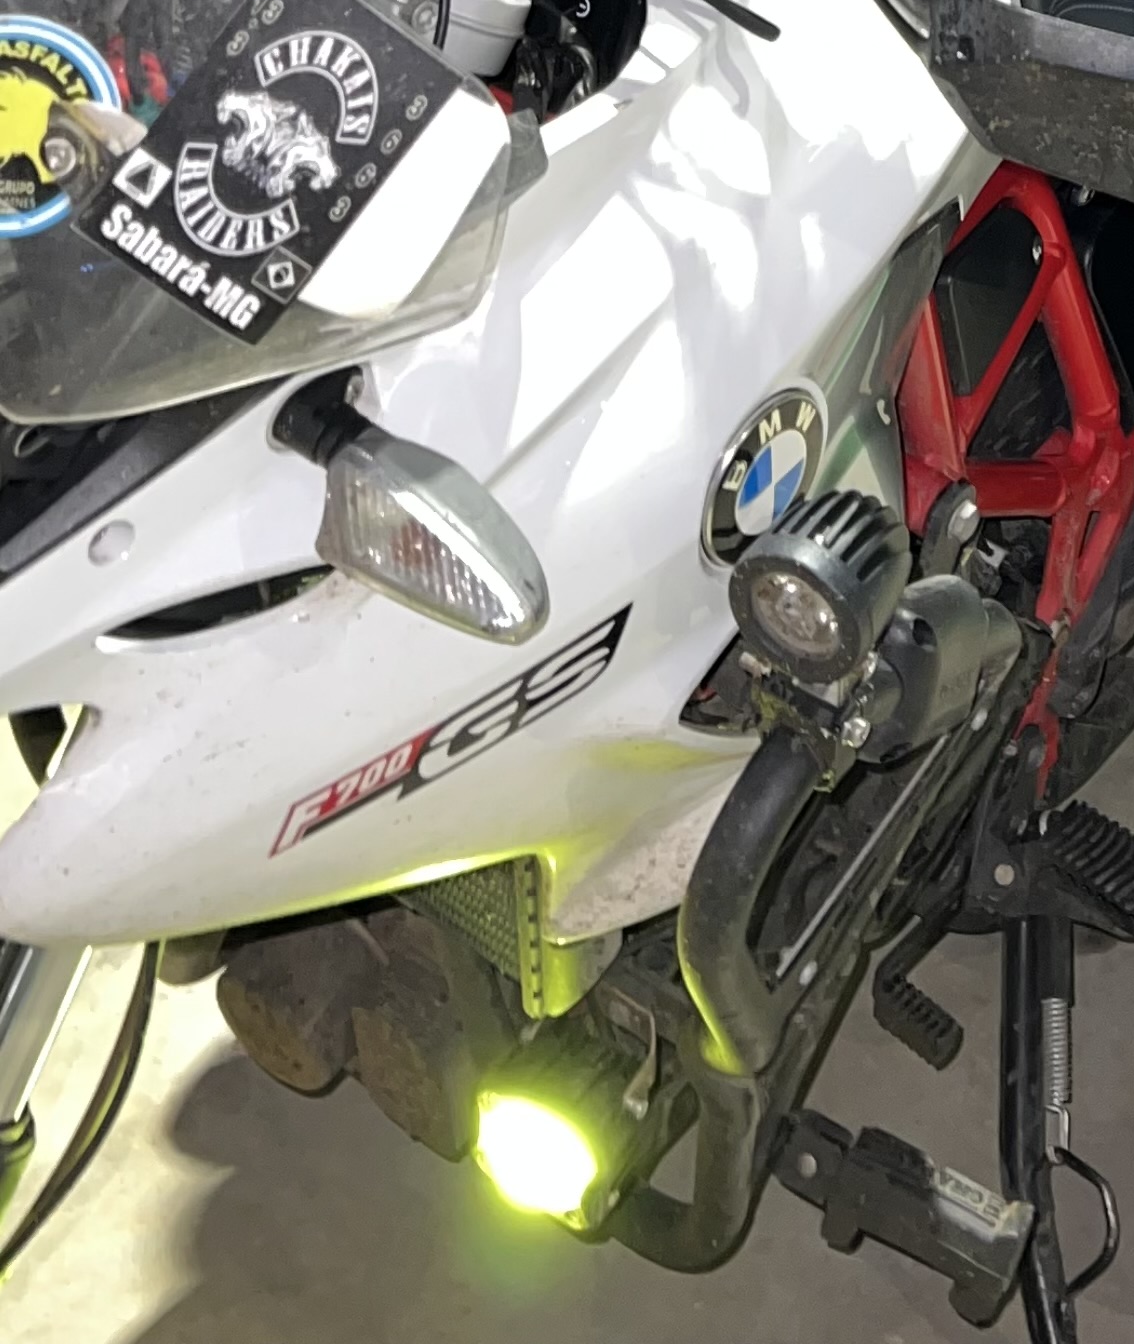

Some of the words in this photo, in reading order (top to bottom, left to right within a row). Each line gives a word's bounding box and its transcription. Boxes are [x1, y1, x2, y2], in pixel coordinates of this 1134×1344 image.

[0, 40, 91, 104] ASFALT
[262, 36, 376, 135] CHAKAIS
[101, 204, 261, 330] Sabará-MG
[722, 401, 816, 491] BMW
